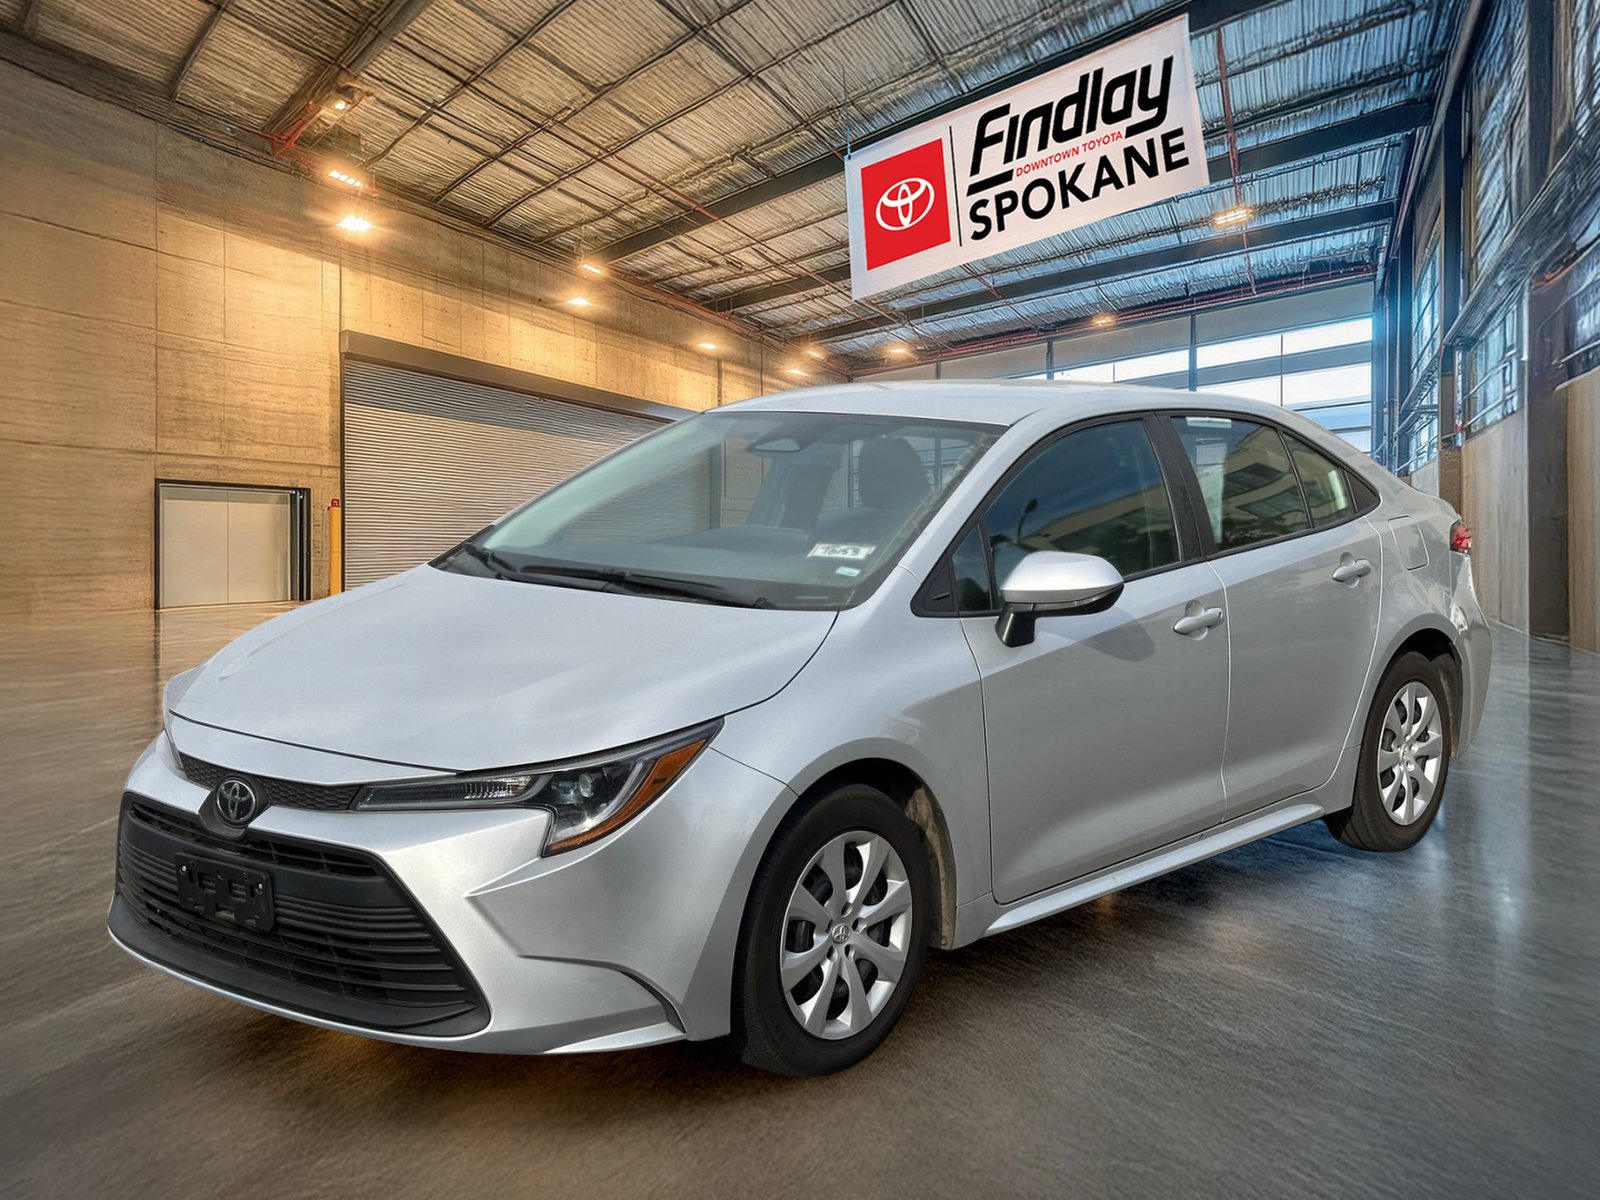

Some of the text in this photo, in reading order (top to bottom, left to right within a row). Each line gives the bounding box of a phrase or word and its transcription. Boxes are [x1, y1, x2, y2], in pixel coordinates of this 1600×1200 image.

[969, 55, 1174, 177] Findlay
[1015, 130, 1124, 177] DOWNTOWN TOYOTA
[969, 127, 1190, 241] SPOKANE
